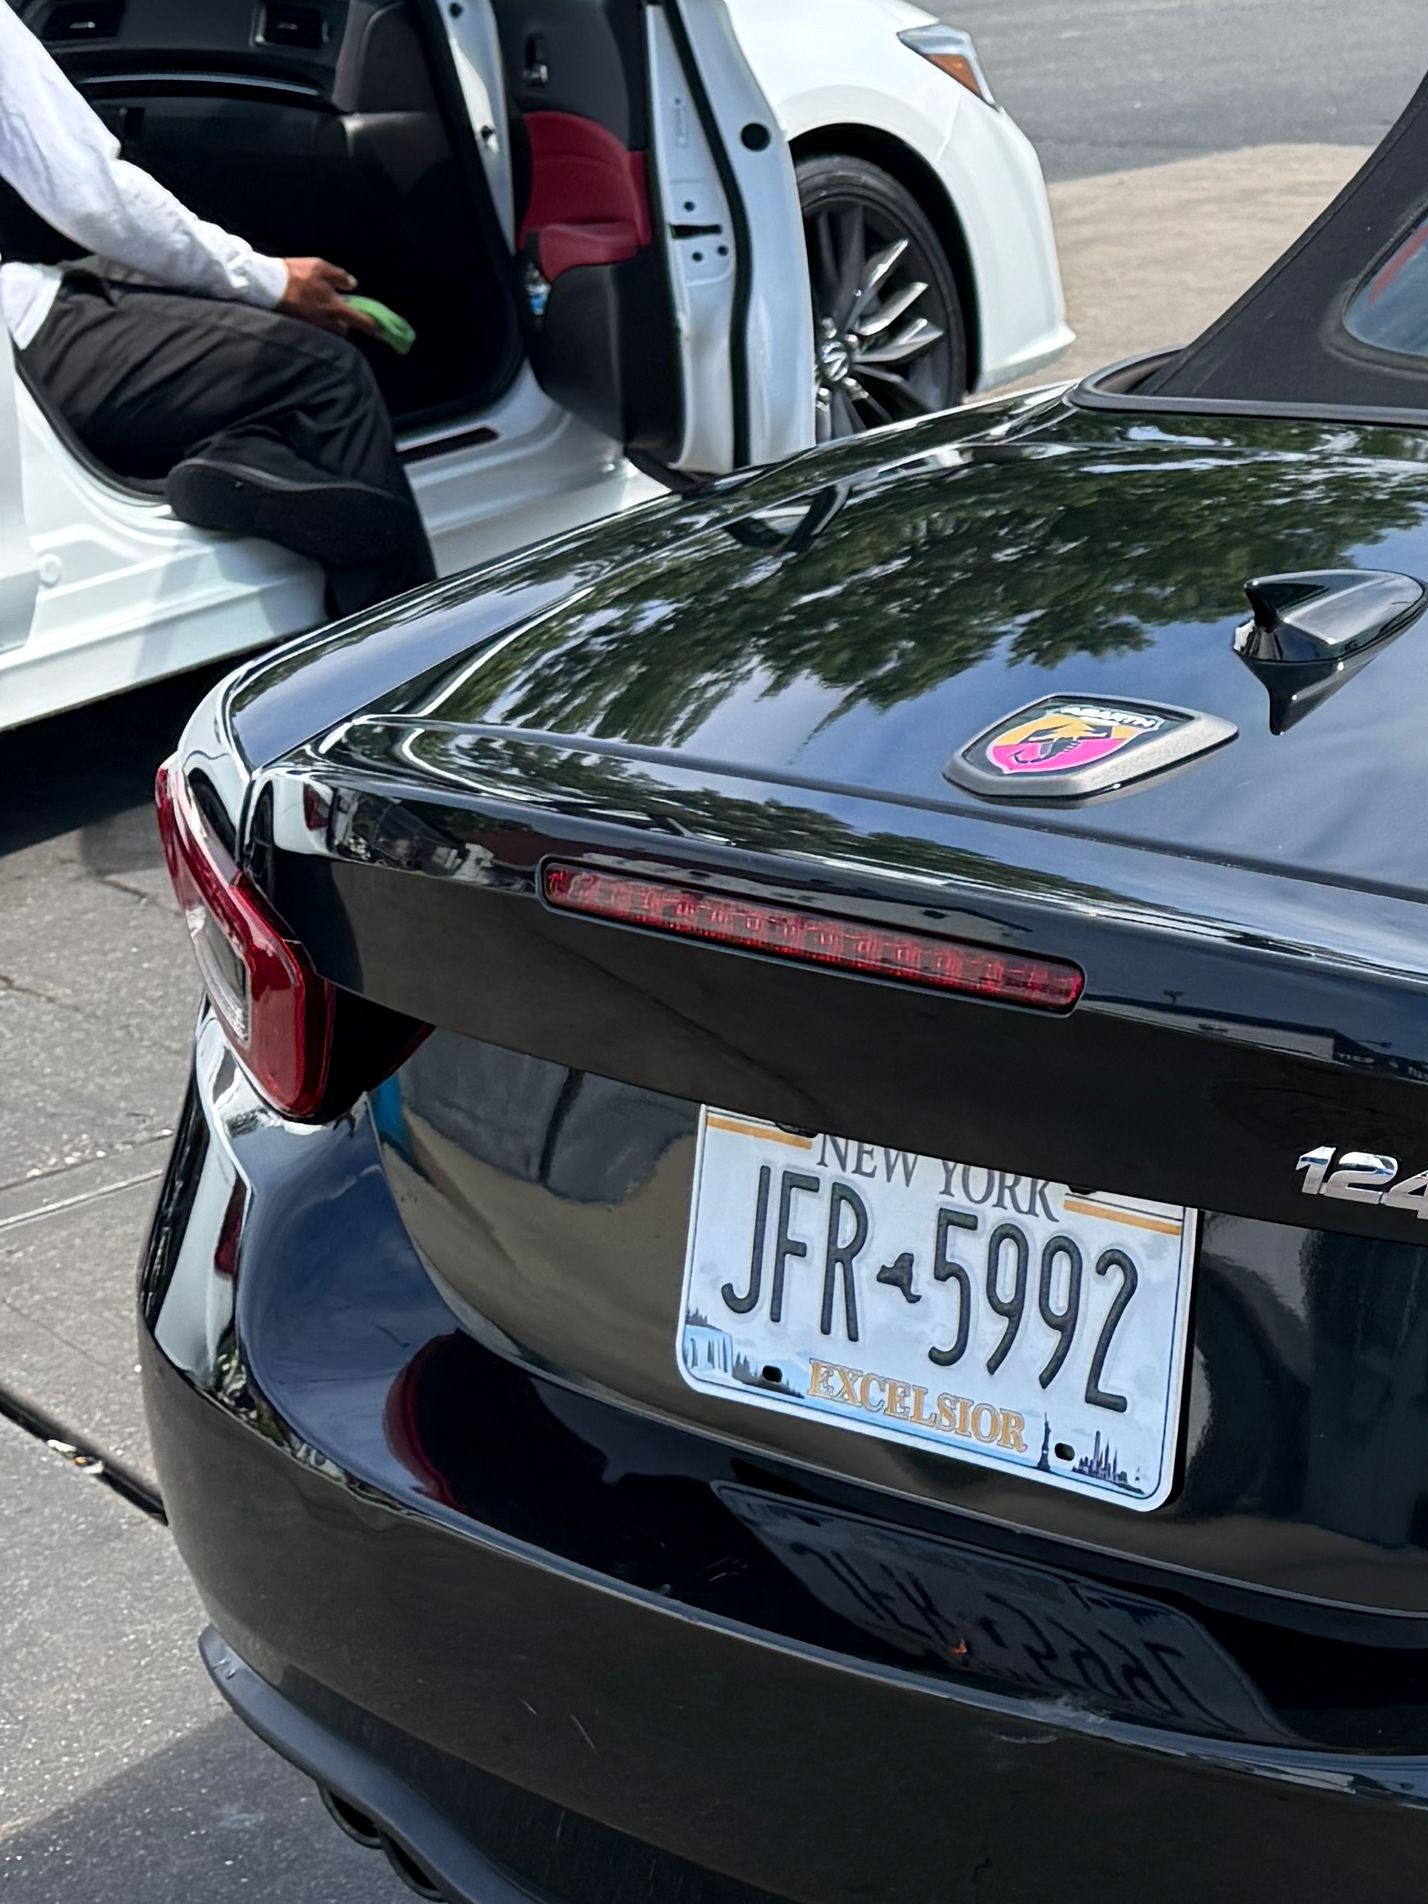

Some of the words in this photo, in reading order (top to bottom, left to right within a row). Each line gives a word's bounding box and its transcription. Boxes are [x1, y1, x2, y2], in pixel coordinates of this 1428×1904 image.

[816, 1133, 920, 1188] NEW
[940, 1156, 1060, 1222] YORK
[721, 1165, 868, 1343] JFR
[928, 1207, 1139, 1414] 5992
[807, 1357, 1028, 1454] EXCELSIOR
